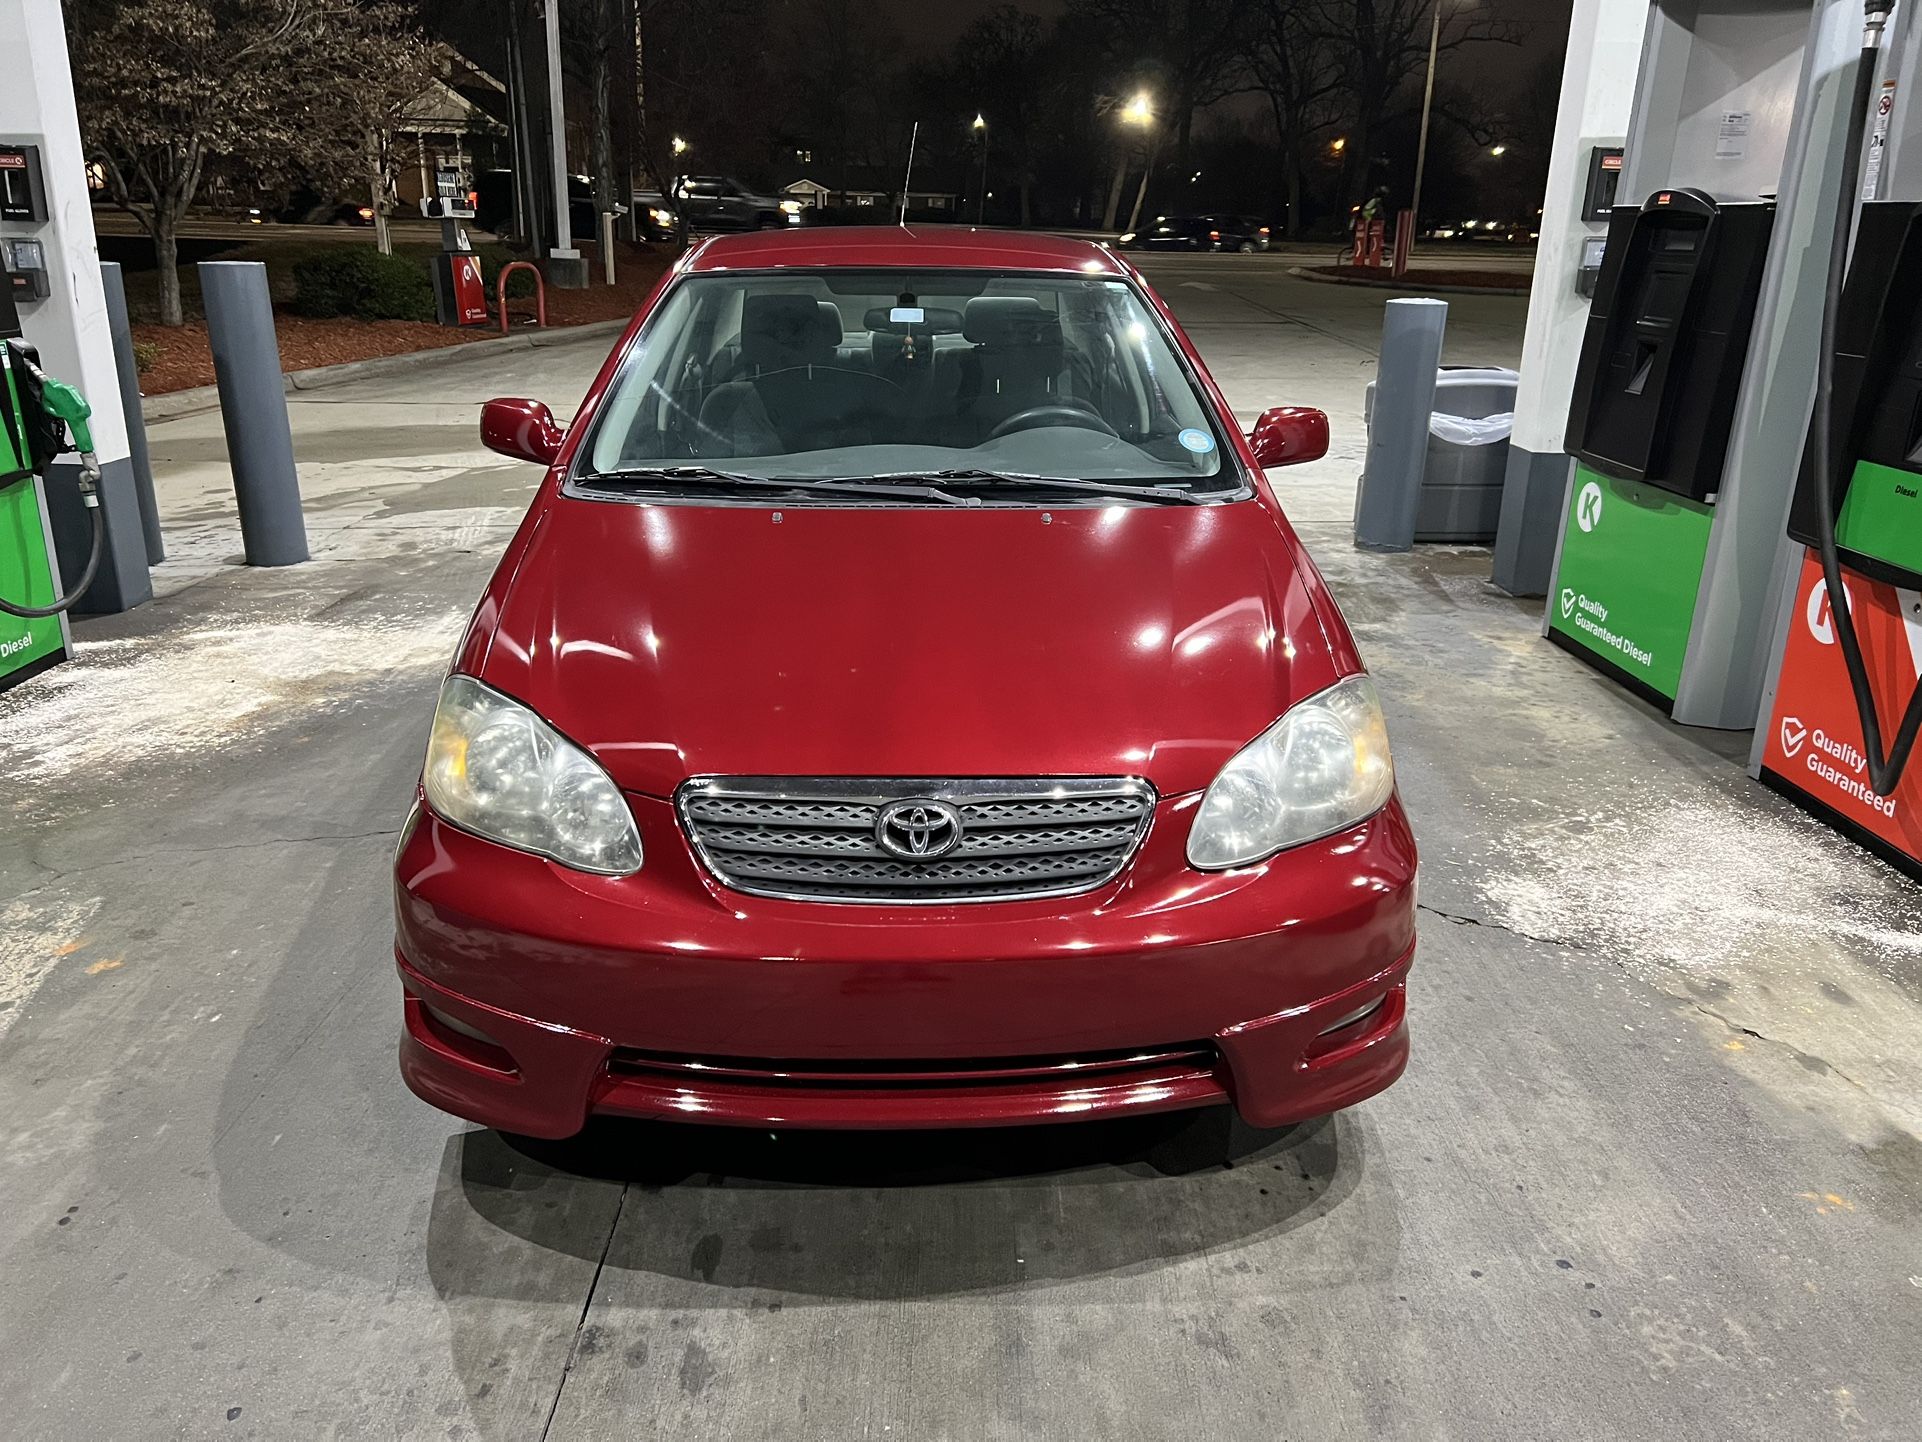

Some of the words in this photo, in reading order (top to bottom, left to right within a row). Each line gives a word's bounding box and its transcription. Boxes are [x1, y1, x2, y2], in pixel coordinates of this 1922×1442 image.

[1580, 487, 1600, 531] K
[1895, 484, 1918, 498] Diesel
[1578, 594, 1608, 622] Quality
[1, 631, 32, 657] Diesel
[1575, 612, 1623, 649] Guaranteed
[1622, 639, 1652, 667] Diesel
[1812, 729, 1867, 774] Quality
[1806, 753, 1896, 818] Guaranteed
